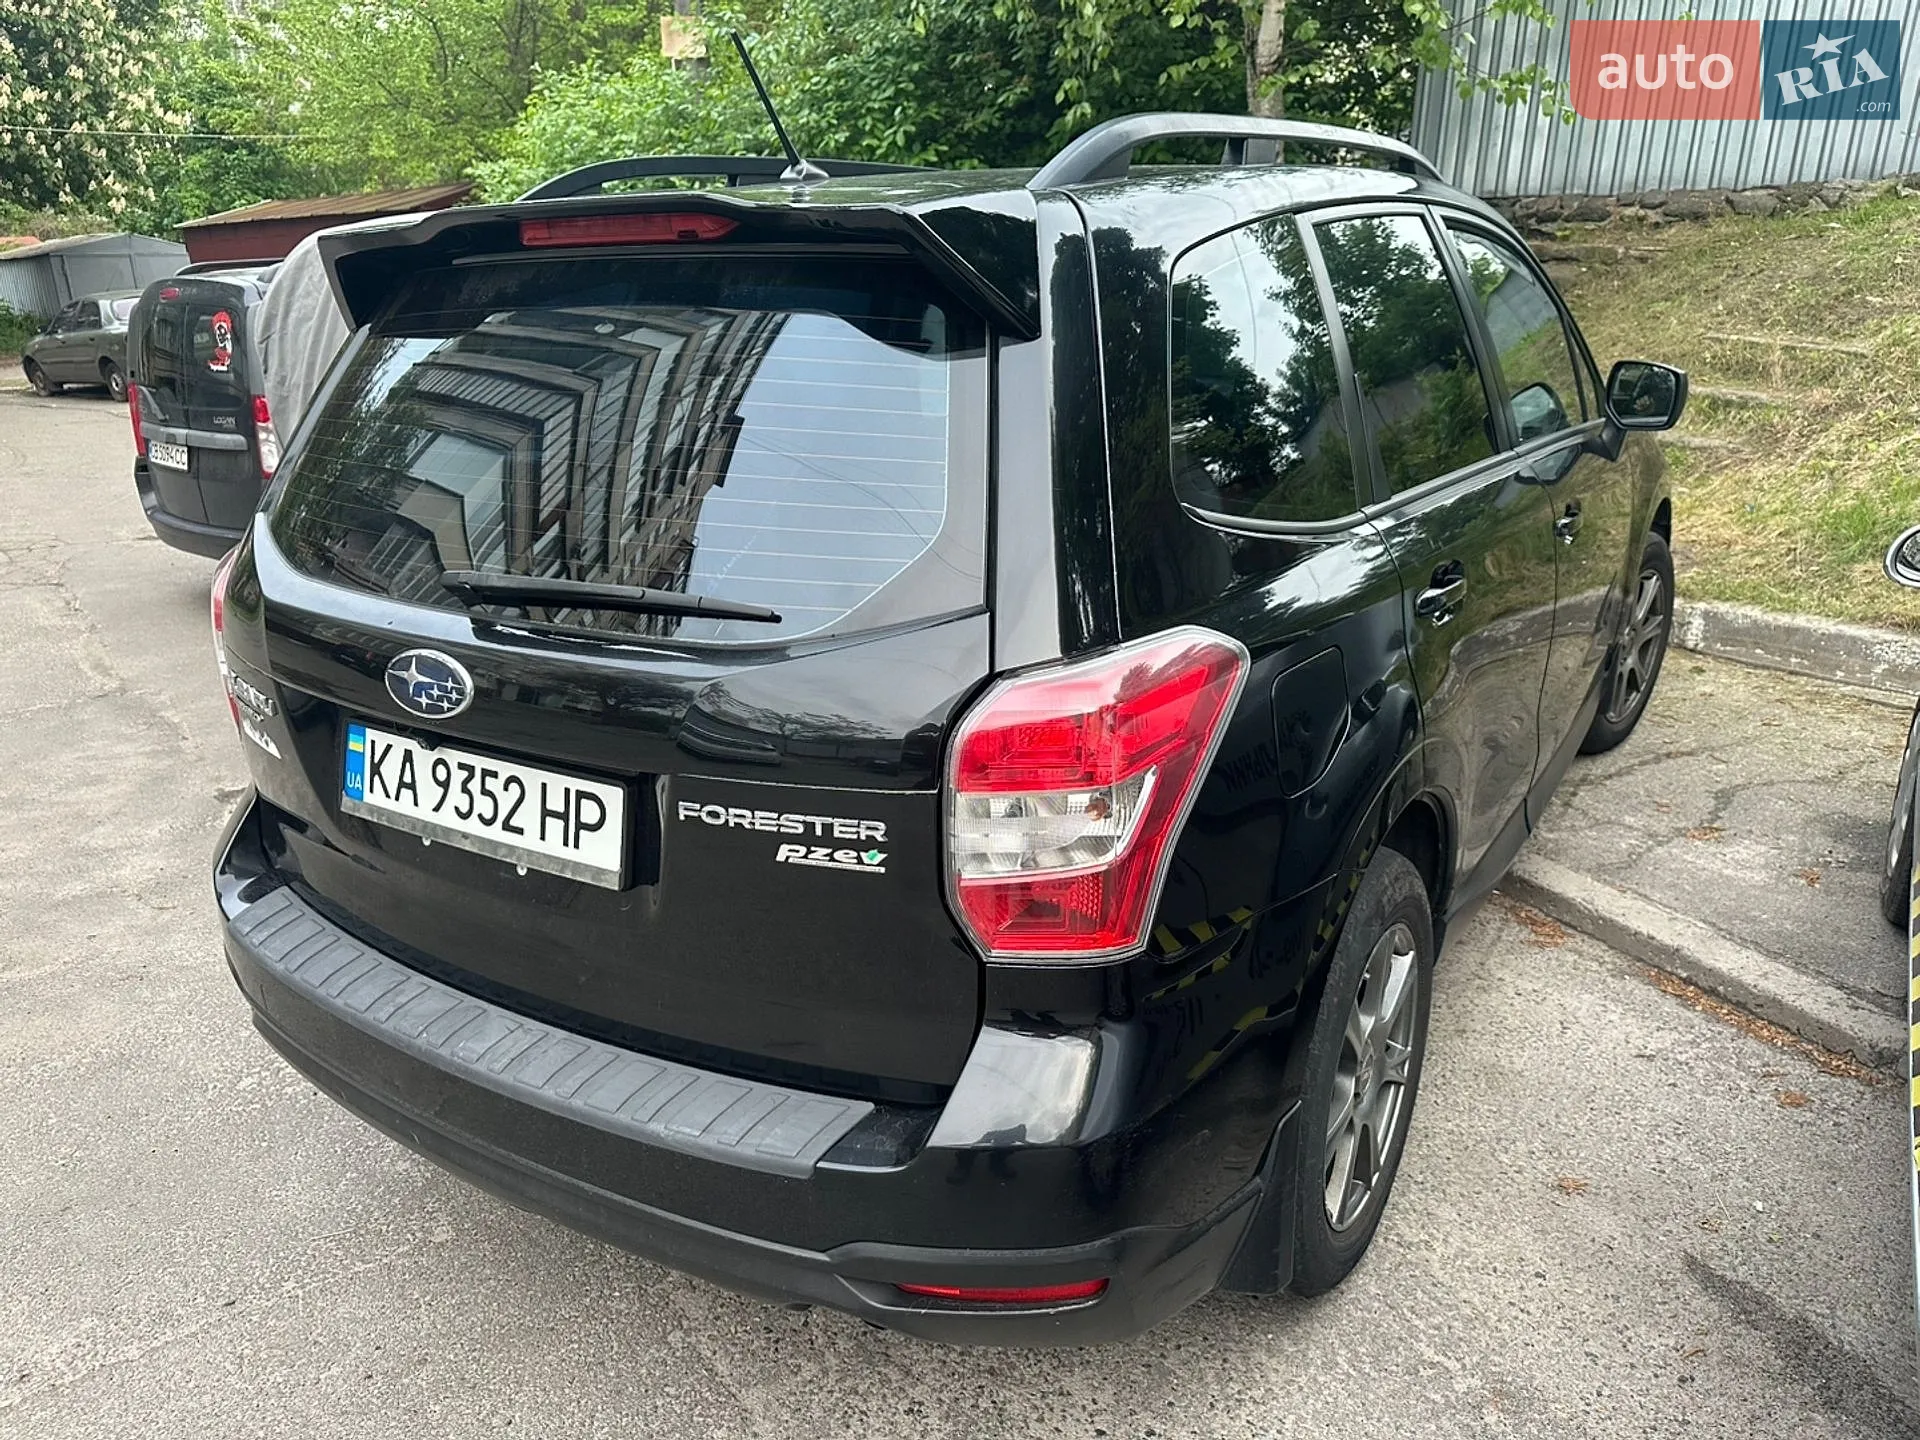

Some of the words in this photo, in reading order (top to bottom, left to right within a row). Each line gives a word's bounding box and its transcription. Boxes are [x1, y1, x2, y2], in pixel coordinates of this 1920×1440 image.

[213, 415, 236, 425] LOGAN
[346, 771, 363, 791] UA
[369, 739, 419, 808] KA
[431, 757, 526, 836] 9352
[539, 781, 607, 850] HP
[677, 800, 888, 842] FORESTER
